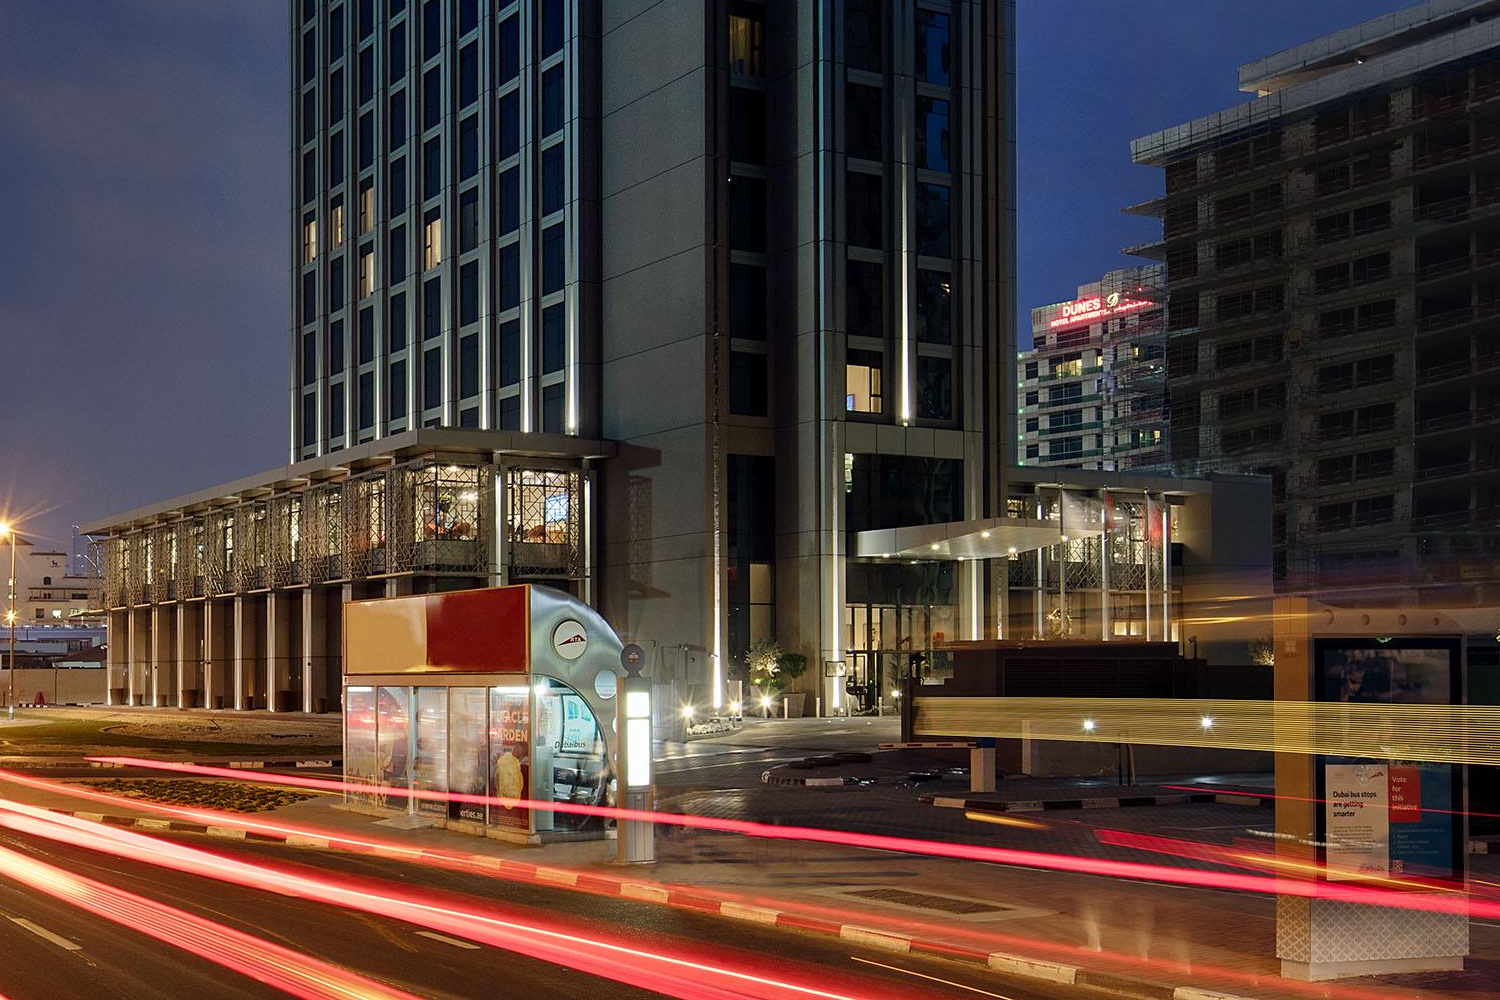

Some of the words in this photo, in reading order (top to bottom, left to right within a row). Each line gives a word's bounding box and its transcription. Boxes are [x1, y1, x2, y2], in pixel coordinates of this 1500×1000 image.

[1063, 299, 1100, 317] DUNES
[1050, 317, 1069, 328] HOTEL
[490, 711, 529, 724] RACLE
[491, 728, 528, 742] ARDEN
[1391, 775, 1406, 783] Vote
[1333, 790, 1349, 798] Dubai
[1350, 790, 1360, 798] bus
[1361, 791, 1377, 799] stops
[1344, 800, 1364, 809] getting
[1333, 810, 1355, 818] smarter
